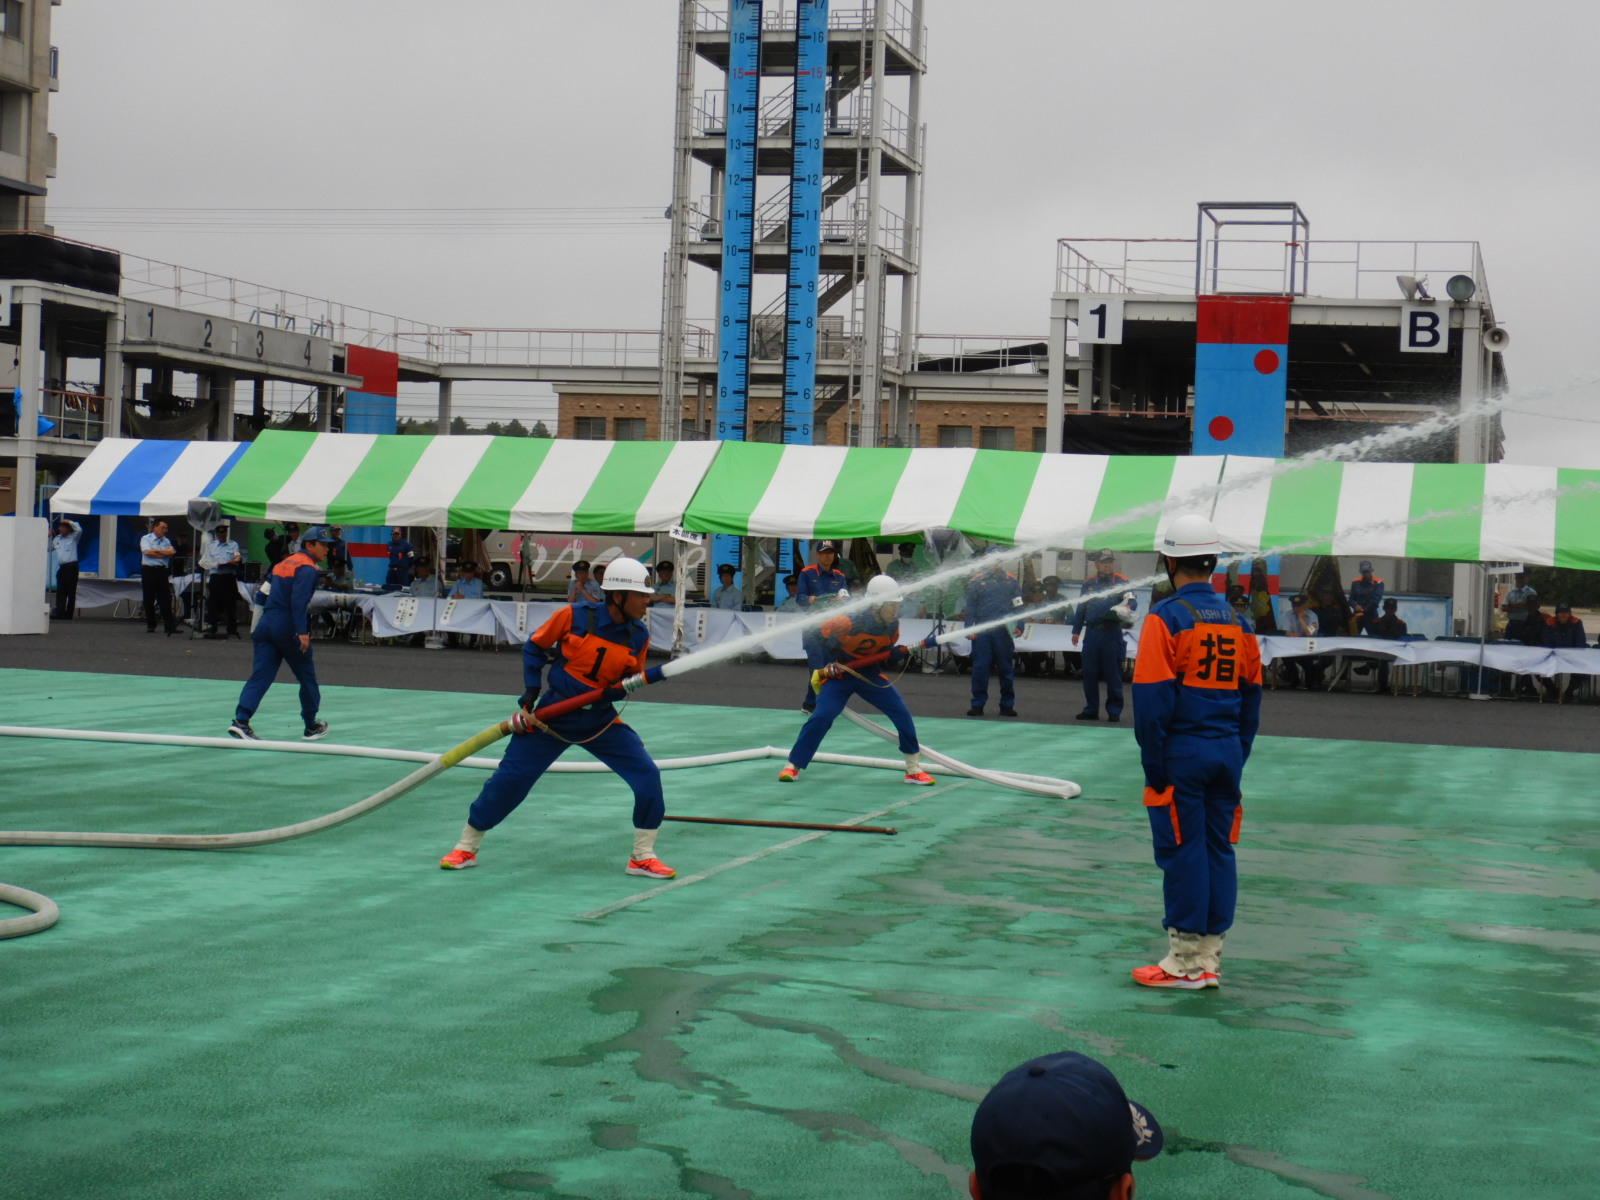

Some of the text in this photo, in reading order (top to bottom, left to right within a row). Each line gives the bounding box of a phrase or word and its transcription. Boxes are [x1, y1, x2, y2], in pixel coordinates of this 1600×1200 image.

[734, 33, 745, 44] 16
[813, 32, 824, 43] 16
[733, 68, 744, 79] 15
[811, 67, 822, 79] 15
[731, 103, 742, 115] 14
[810, 103, 821, 114] 14
[730, 138, 741, 150] 13
[809, 138, 820, 150] 13
[728, 174, 740, 186] 12
[808, 174, 819, 186] 12
[727, 210, 738, 221] 11
[806, 210, 817, 221] 11
[726, 245, 737, 257] 10
[805, 245, 816, 257] 10
[724, 280, 731, 291] 9
[807, 281, 815, 292] 9
[722, 315, 730, 327] 8
[806, 316, 813, 328] 8
[1089, 303, 1107, 339] 1
[1408, 311, 1441, 347] B
[147, 308, 311, 366] 1 2 3 4
[722, 351, 729, 362] 7
[805, 352, 812, 364] 7
[720, 386, 727, 398] 6
[803, 388, 811, 400] 6
[719, 422, 726, 433] 5
[802, 424, 809, 436] 5
[852, 639, 877, 655] 2
[1196, 633, 1236, 682] 指
[583, 647, 607, 682] 1
